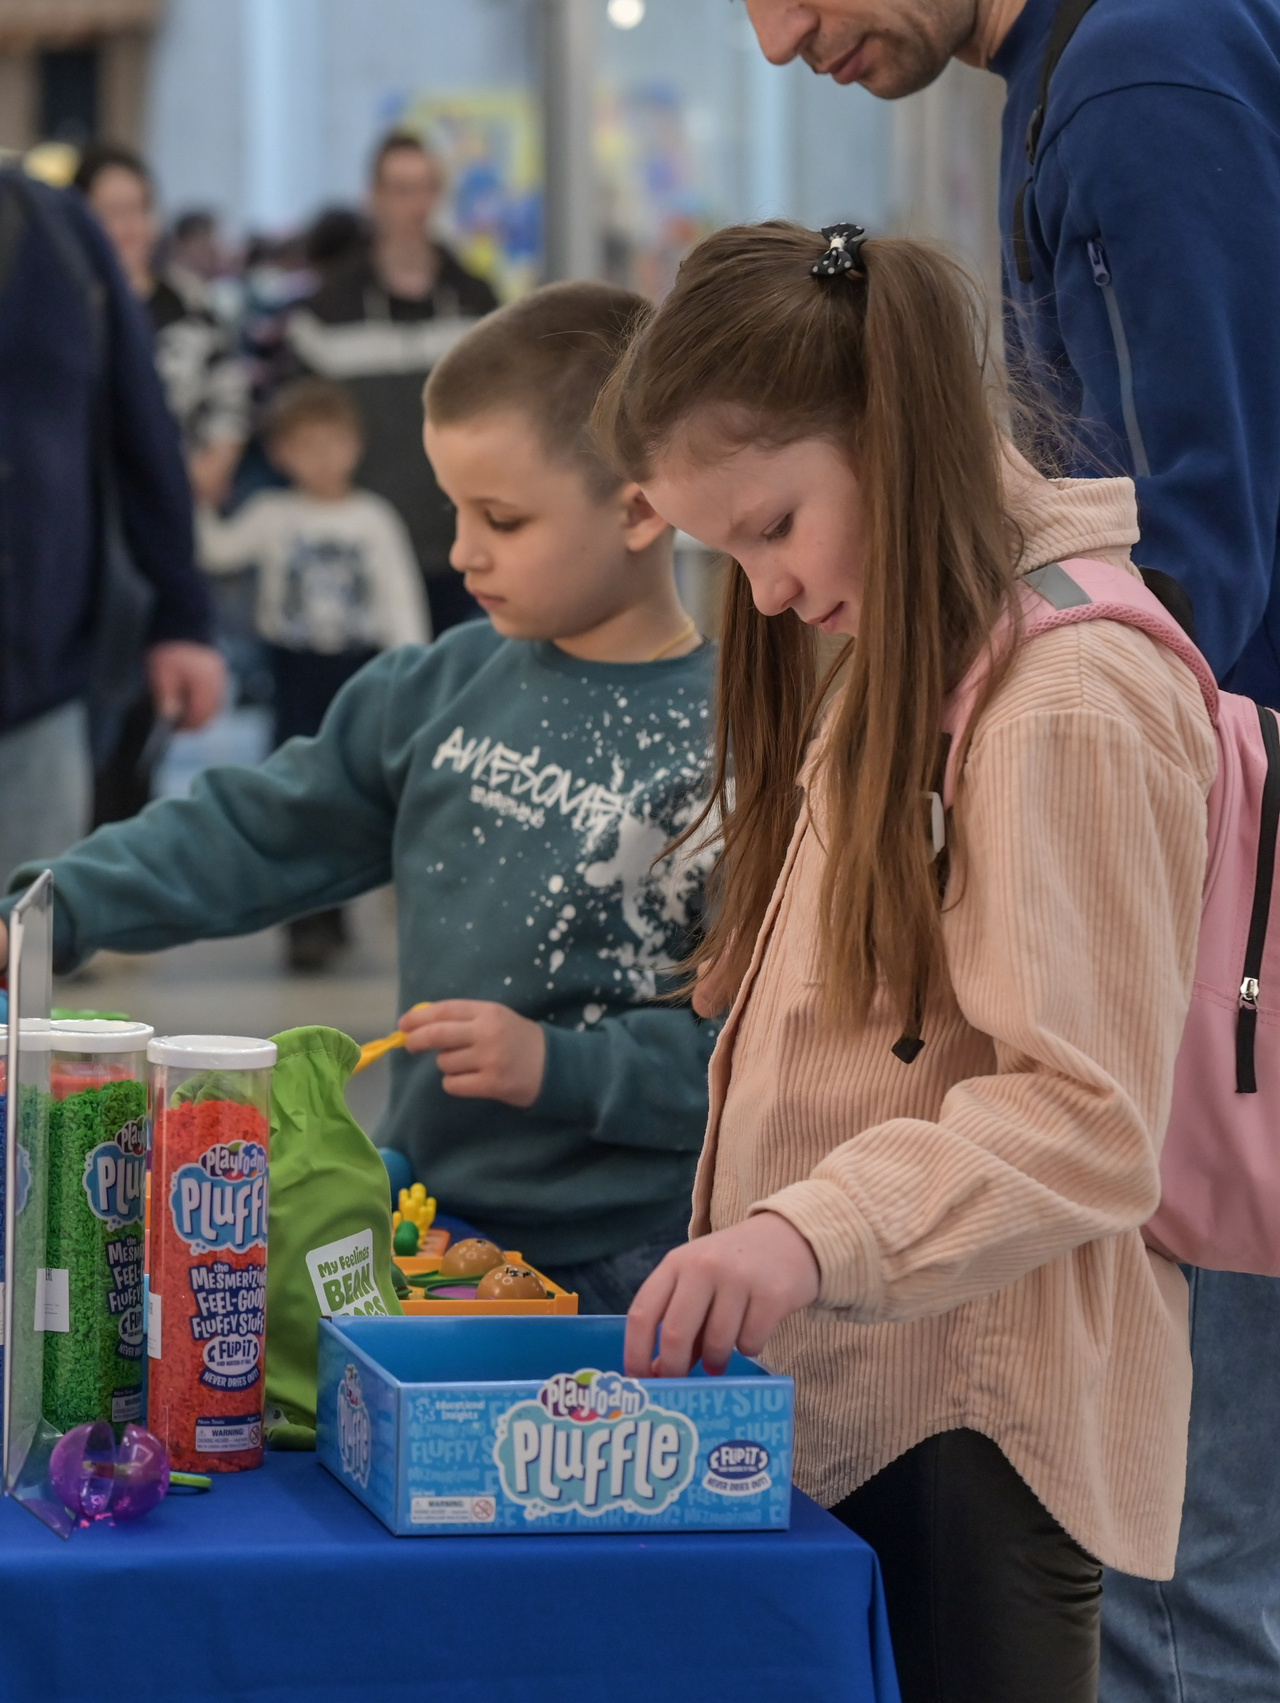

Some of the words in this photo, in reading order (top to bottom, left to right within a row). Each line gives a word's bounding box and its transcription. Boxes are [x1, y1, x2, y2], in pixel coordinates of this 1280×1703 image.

[431, 726, 623, 829] AWESOME
[206, 1144, 266, 1177] Playfoam
[213, 1263, 230, 1272] the
[318, 1260, 338, 1278] My
[339, 1246, 369, 1270] Feelings
[196, 1288, 265, 1316] FEEL-GOOD
[323, 1263, 374, 1312] BEAN
[192, 1314, 238, 1338] FLUFFY
[202, 1372, 226, 1387] NEVER
[546, 1375, 641, 1417] Playfoam
[514, 1420, 680, 1506] Pluffle
